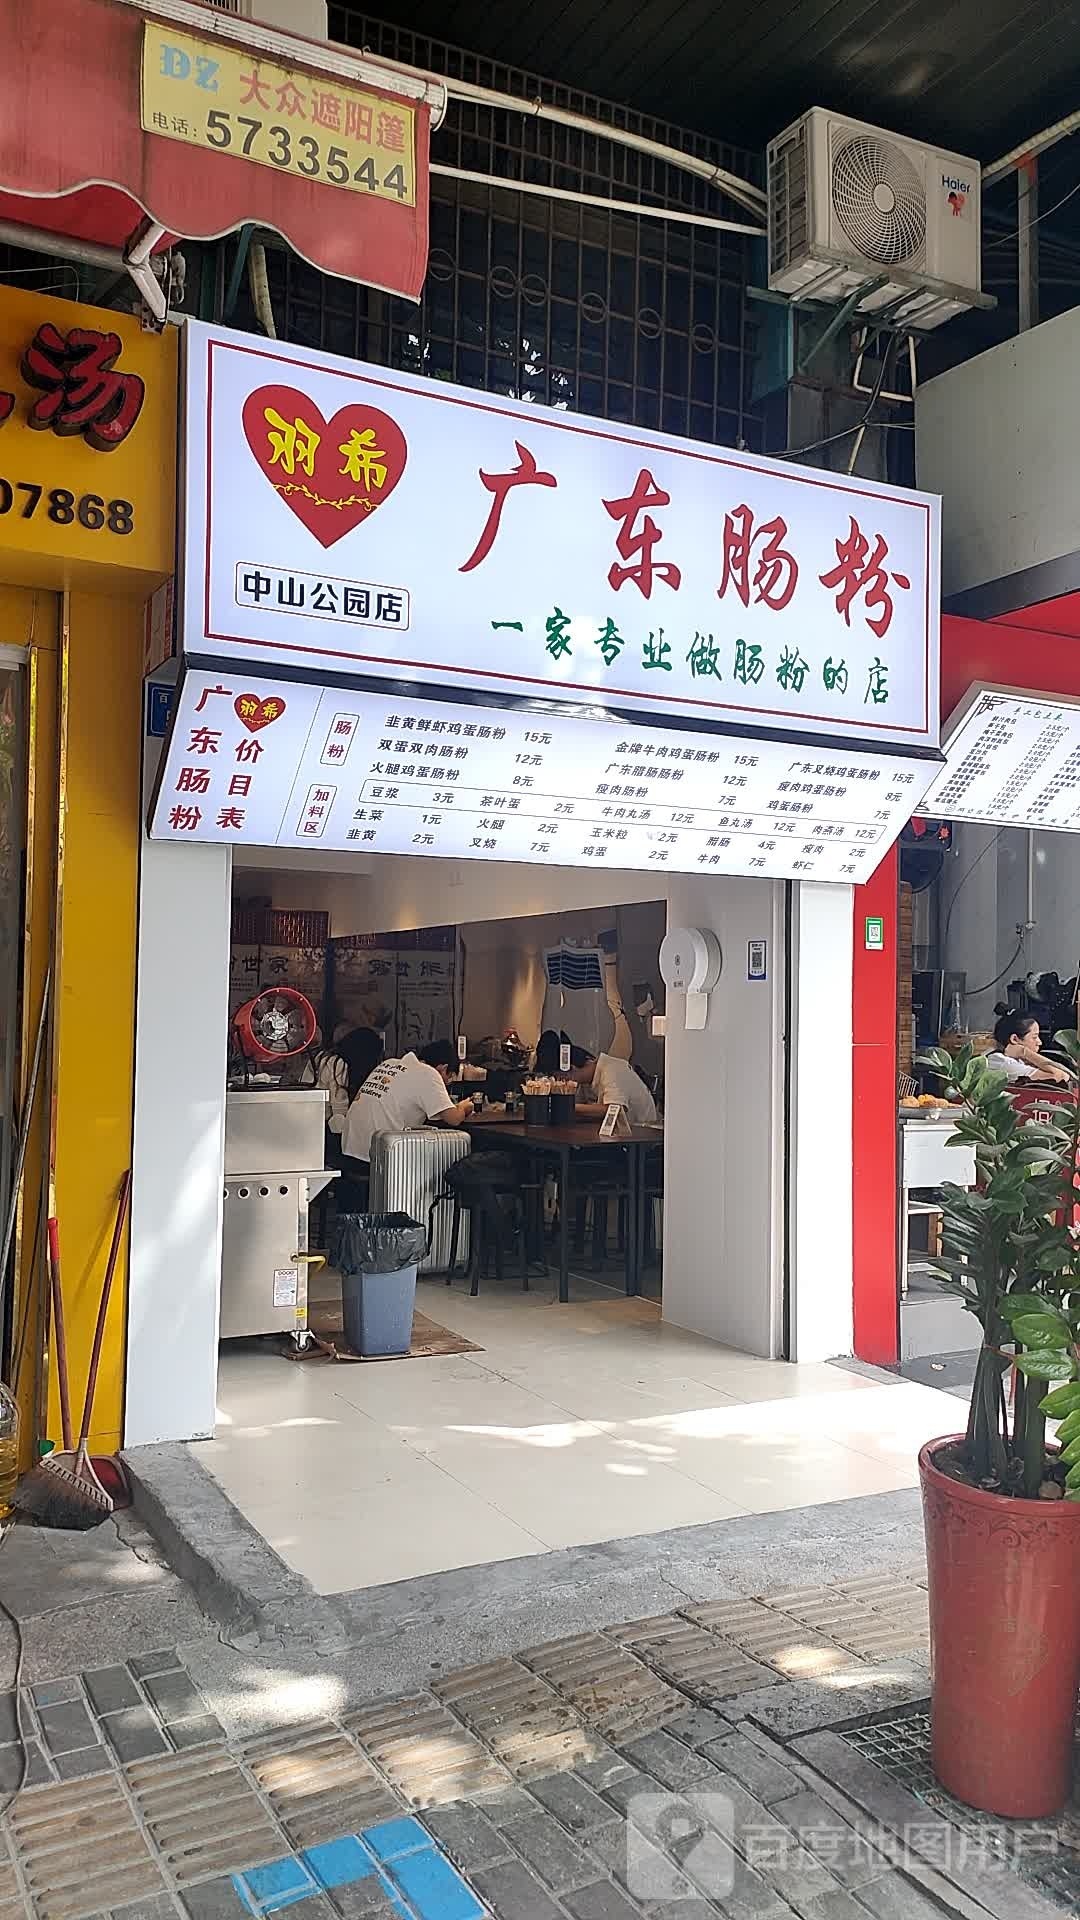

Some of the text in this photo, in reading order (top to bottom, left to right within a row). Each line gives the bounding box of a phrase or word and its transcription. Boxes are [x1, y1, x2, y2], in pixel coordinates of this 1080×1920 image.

[160, 42, 221, 92] DZ
[239, 69, 407, 154] 大众遮阳篷
[206, 109, 408, 199] 5733544
[942, 175, 971, 194] Haier
[0, 321, 146, 452] 汤
[263, 406, 388, 492] 羽希
[459, 439, 911, 638] 广东肠粉
[243, 571, 403, 623] 中山公园店
[491, 607, 889, 705] 一家专业做肠粉的店
[239, 698, 279, 719] 羽希
[327, 719, 352, 759] 肠粉
[384, 714, 553, 745] 韭黄鲜虾鸡蛋肠粉 15元
[167, 685, 233, 831] 广东肠粉
[377, 738, 543, 766] 双蛋双肉肠粉 12元
[615, 741, 759, 767] 金牌牛肉鸡蛋肠粉 15元
[368, 762, 535, 787] 火腿鸡蛋肠粉 8元
[723, 775, 748, 787] 12元
[788, 762, 915, 784] 广东叉烧鸡蛋肠粉 15元
[216, 738, 264, 830] 价目表
[595, 783, 737, 806] 瘦肉肠粉 7元
[777, 781, 903, 802] 瘦肉鸡蛋肠粉 8元
[369, 786, 455, 804] 豆浆 3元
[479, 796, 576, 814] 茶叶蛋 2元
[304, 788, 330, 834] 加料区
[353, 808, 443, 825] 生菜 1元
[602, 807, 695, 824] 牛肉丸汤 12元
[766, 800, 891, 820] 鸡蛋肠粉 7元
[477, 818, 559, 834] 火腿 2元
[590, 827, 678, 843] 玉米粒 2元
[718, 816, 797, 833] 鱼丸汤 12元
[855, 829, 877, 840] 12元
[345, 828, 435, 846] 韭黄 2元
[469, 837, 551, 853] 叉烧 7元
[757, 840, 776, 851] 4元
[581, 846, 669, 861] 鸡蛋 2元
[697, 854, 767, 867] 牛肉 7元
[849, 848, 867, 858] 2元
[792, 861, 857, 874] 虾仁 7元
